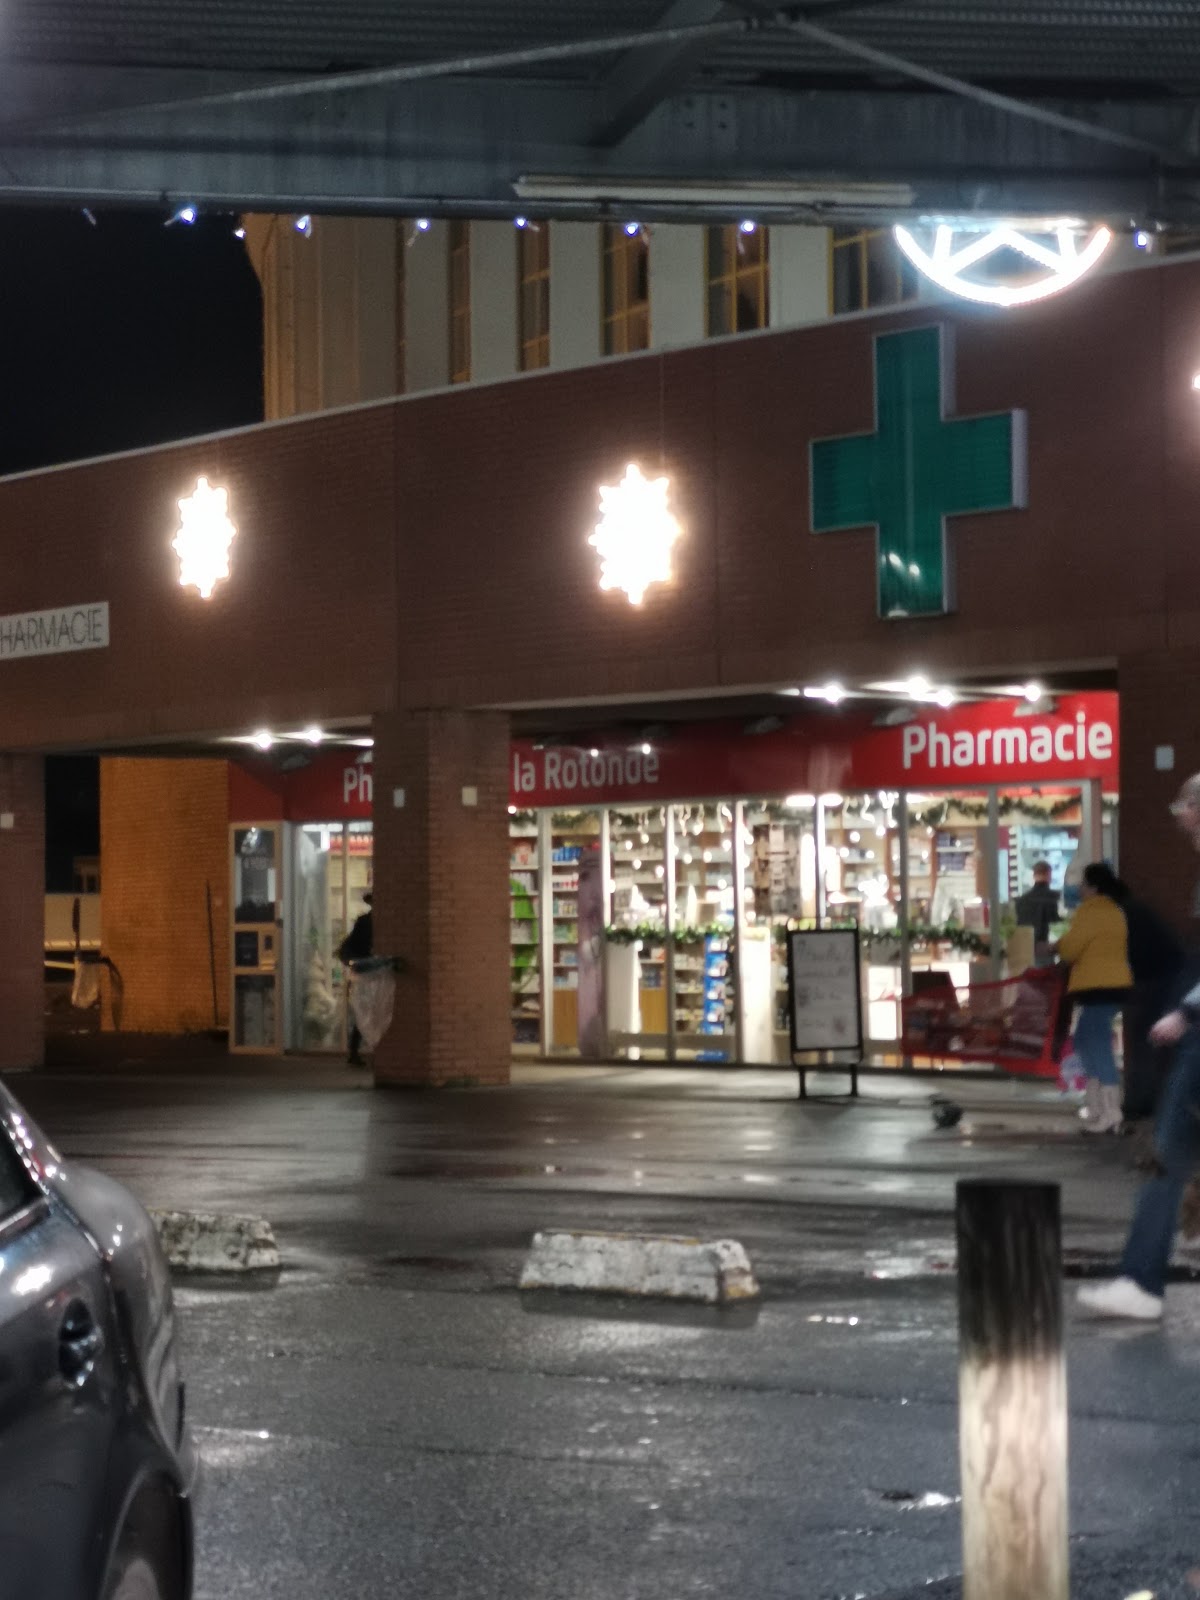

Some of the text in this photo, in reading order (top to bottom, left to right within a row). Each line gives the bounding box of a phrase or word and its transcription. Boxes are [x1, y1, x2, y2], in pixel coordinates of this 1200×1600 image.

[0, 609, 102, 652] HARMACIE
[903, 711, 1112, 769] Pharmacie
[514, 748, 659, 792] la Rotonde
